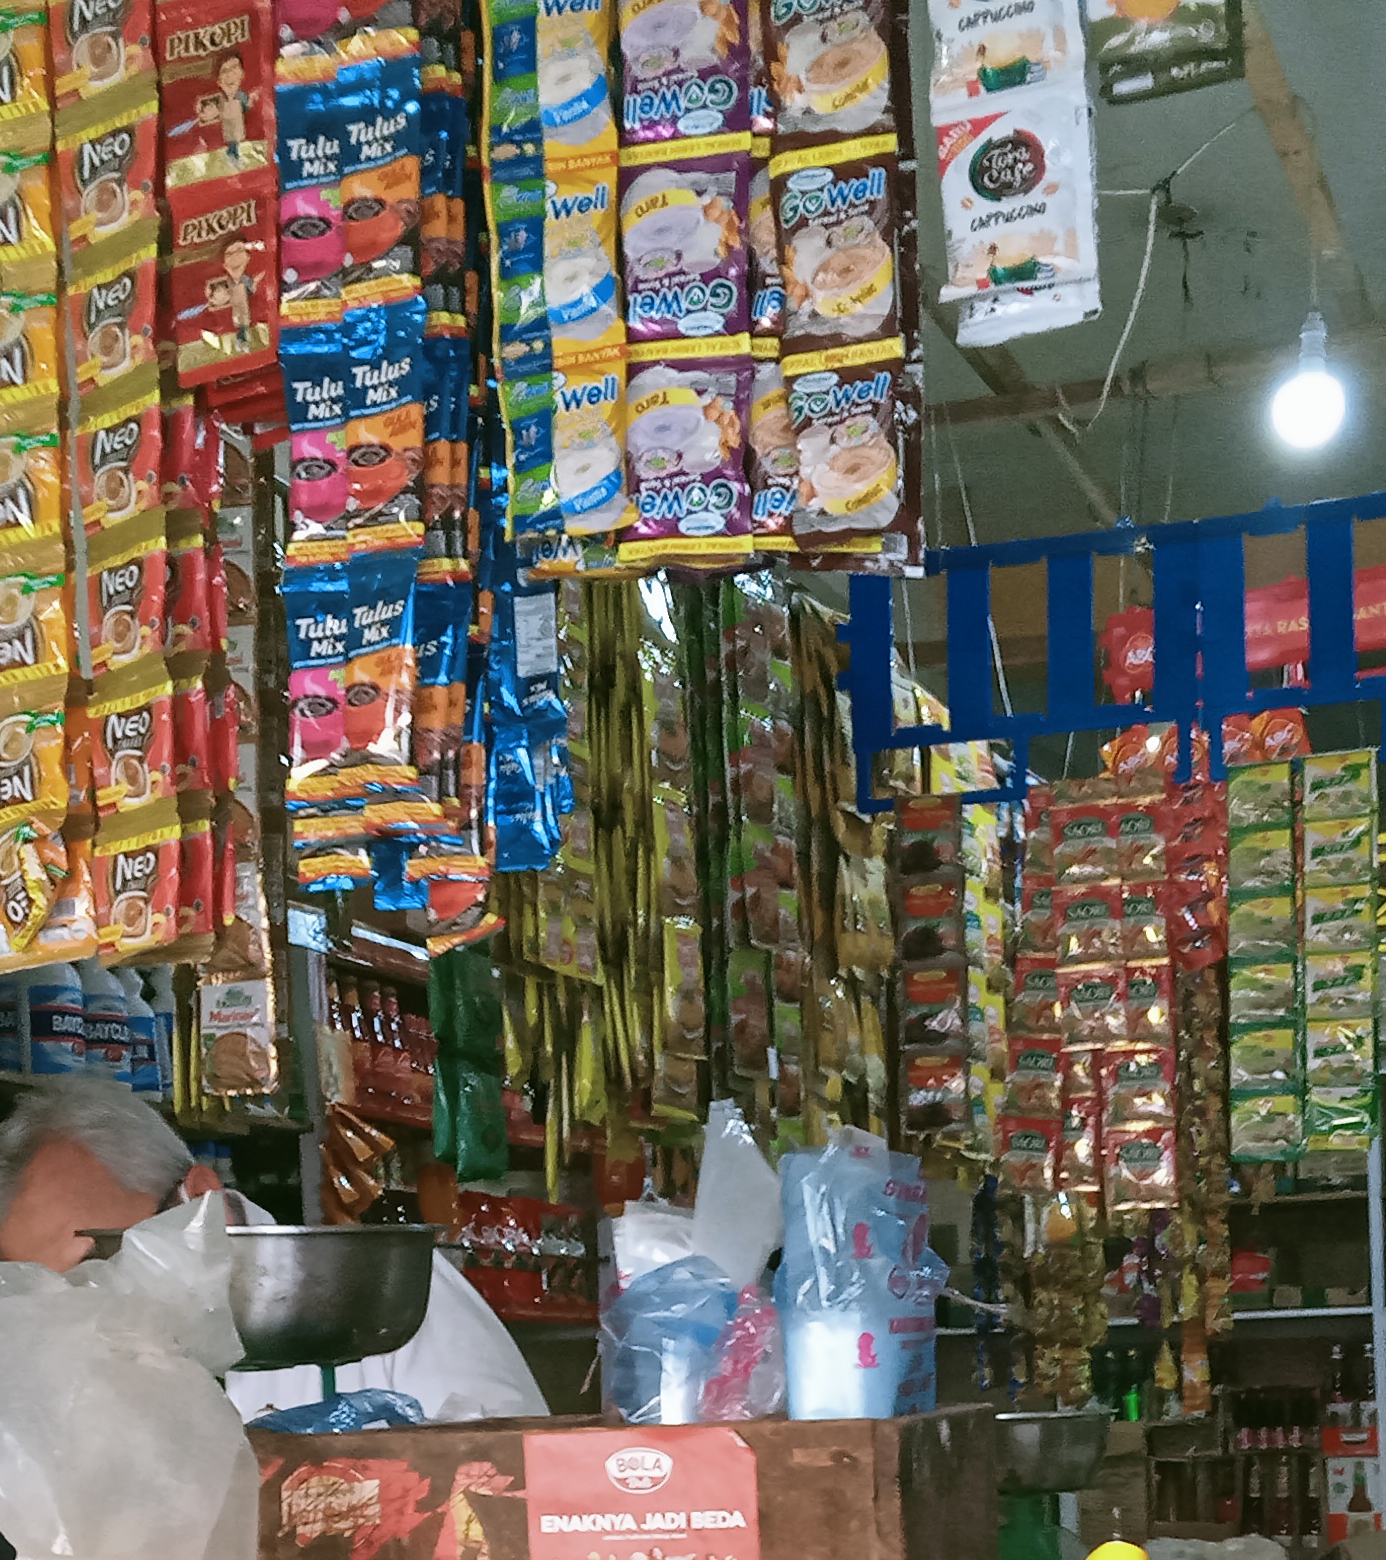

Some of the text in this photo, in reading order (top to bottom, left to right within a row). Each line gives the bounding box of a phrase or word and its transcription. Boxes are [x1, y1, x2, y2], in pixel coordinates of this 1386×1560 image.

[165, 14, 252, 61] PIKOPI
[346, 112, 408, 145] Tulus
[81, 132, 132, 179] NEO
[286, 134, 341, 161] Tulu
[359, 140, 396, 161] Mix
[301, 158, 338, 178] Mix
[179, 198, 257, 246] PIKOPI
[89, 275, 133, 323] NEO
[351, 357, 413, 389] Tulus
[291, 377, 345, 403] Tulu
[365, 384, 399, 406] Mix
[307, 401, 343, 421] Mix
[94, 422, 140, 466] NEO
[101, 564, 141, 607] NEO
[295, 613, 348, 640] Tulu
[352, 599, 405, 629] Tulus
[1277, 615, 1311, 637] RAS
[309, 638, 346, 658] Mix
[362, 624, 392, 646] Mix
[106, 711, 151, 750] NEO
[115, 851, 157, 892] NEO
[616, 1455, 664, 1473] BOLA
[540, 1509, 747, 1534] ENAKNYA JADI BEDA
